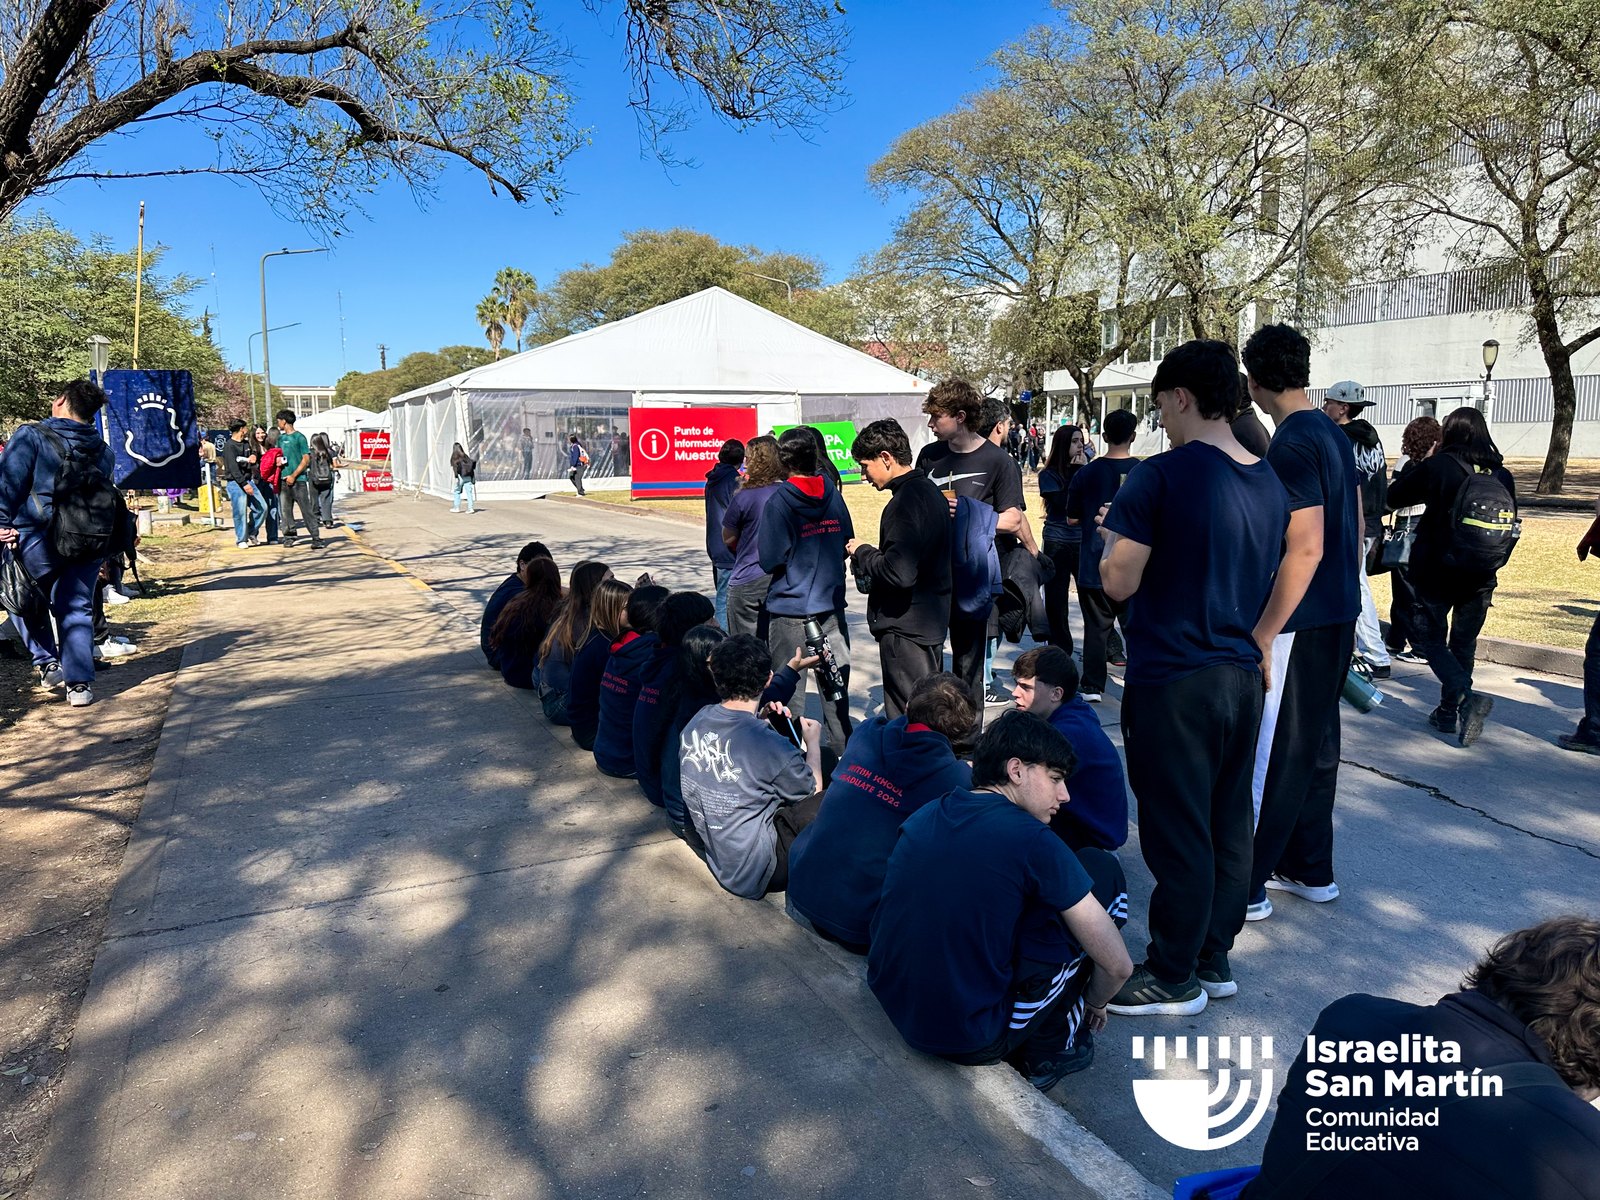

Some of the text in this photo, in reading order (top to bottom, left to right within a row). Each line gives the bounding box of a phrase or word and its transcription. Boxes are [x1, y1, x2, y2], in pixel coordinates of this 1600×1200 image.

[673, 426, 714, 436] Punto de
[674, 438, 725, 448] información
[824, 433, 845, 447] PA
[826, 448, 853, 461] TRA
[872, 775, 904, 798] SCHOOL
[876, 789, 901, 808] 2026
